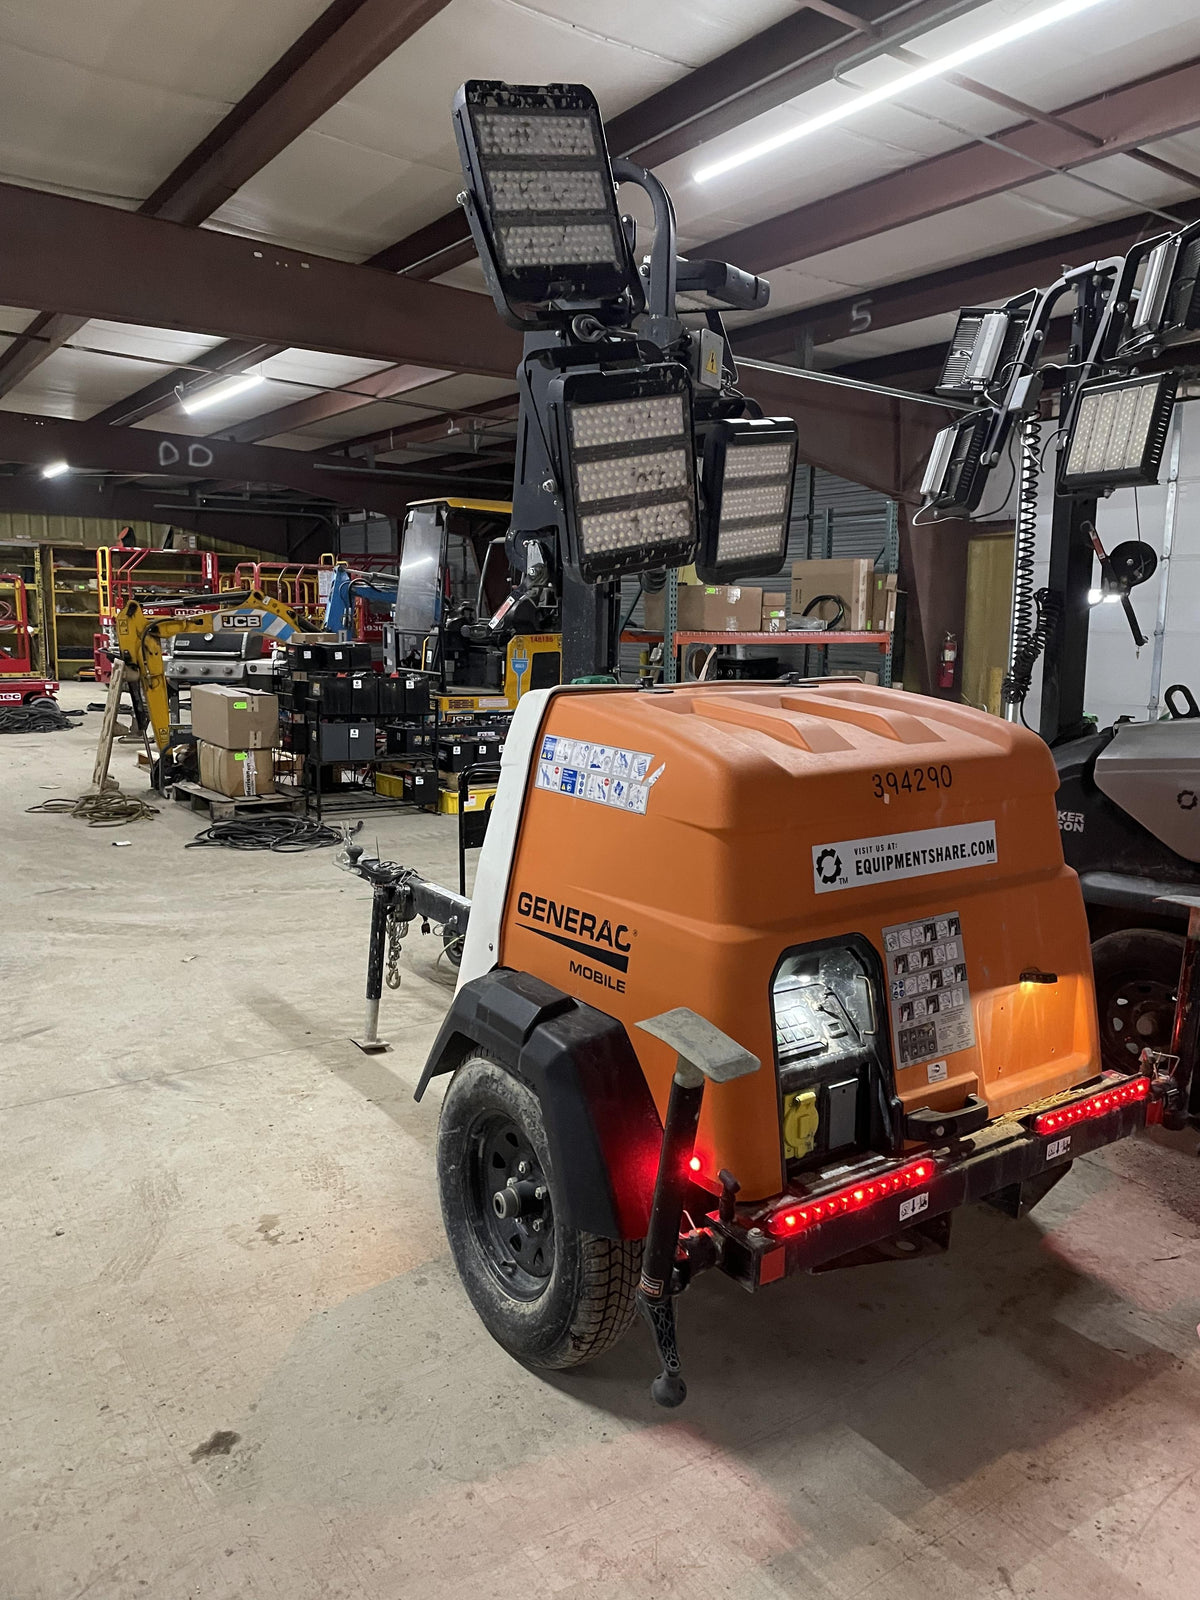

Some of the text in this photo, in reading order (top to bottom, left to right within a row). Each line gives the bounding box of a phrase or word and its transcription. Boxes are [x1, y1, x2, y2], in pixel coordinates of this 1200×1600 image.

[850, 298, 872, 332] 5
[223, 615, 261, 627] JCB
[872, 764, 953, 799] 394290
[854, 842, 898, 856] VISIT US AT:
[855, 839, 996, 876] EQUIPMENTSHARE.COM
[517, 891, 632, 953] GENERAC
[569, 960, 627, 994] MOBILE
